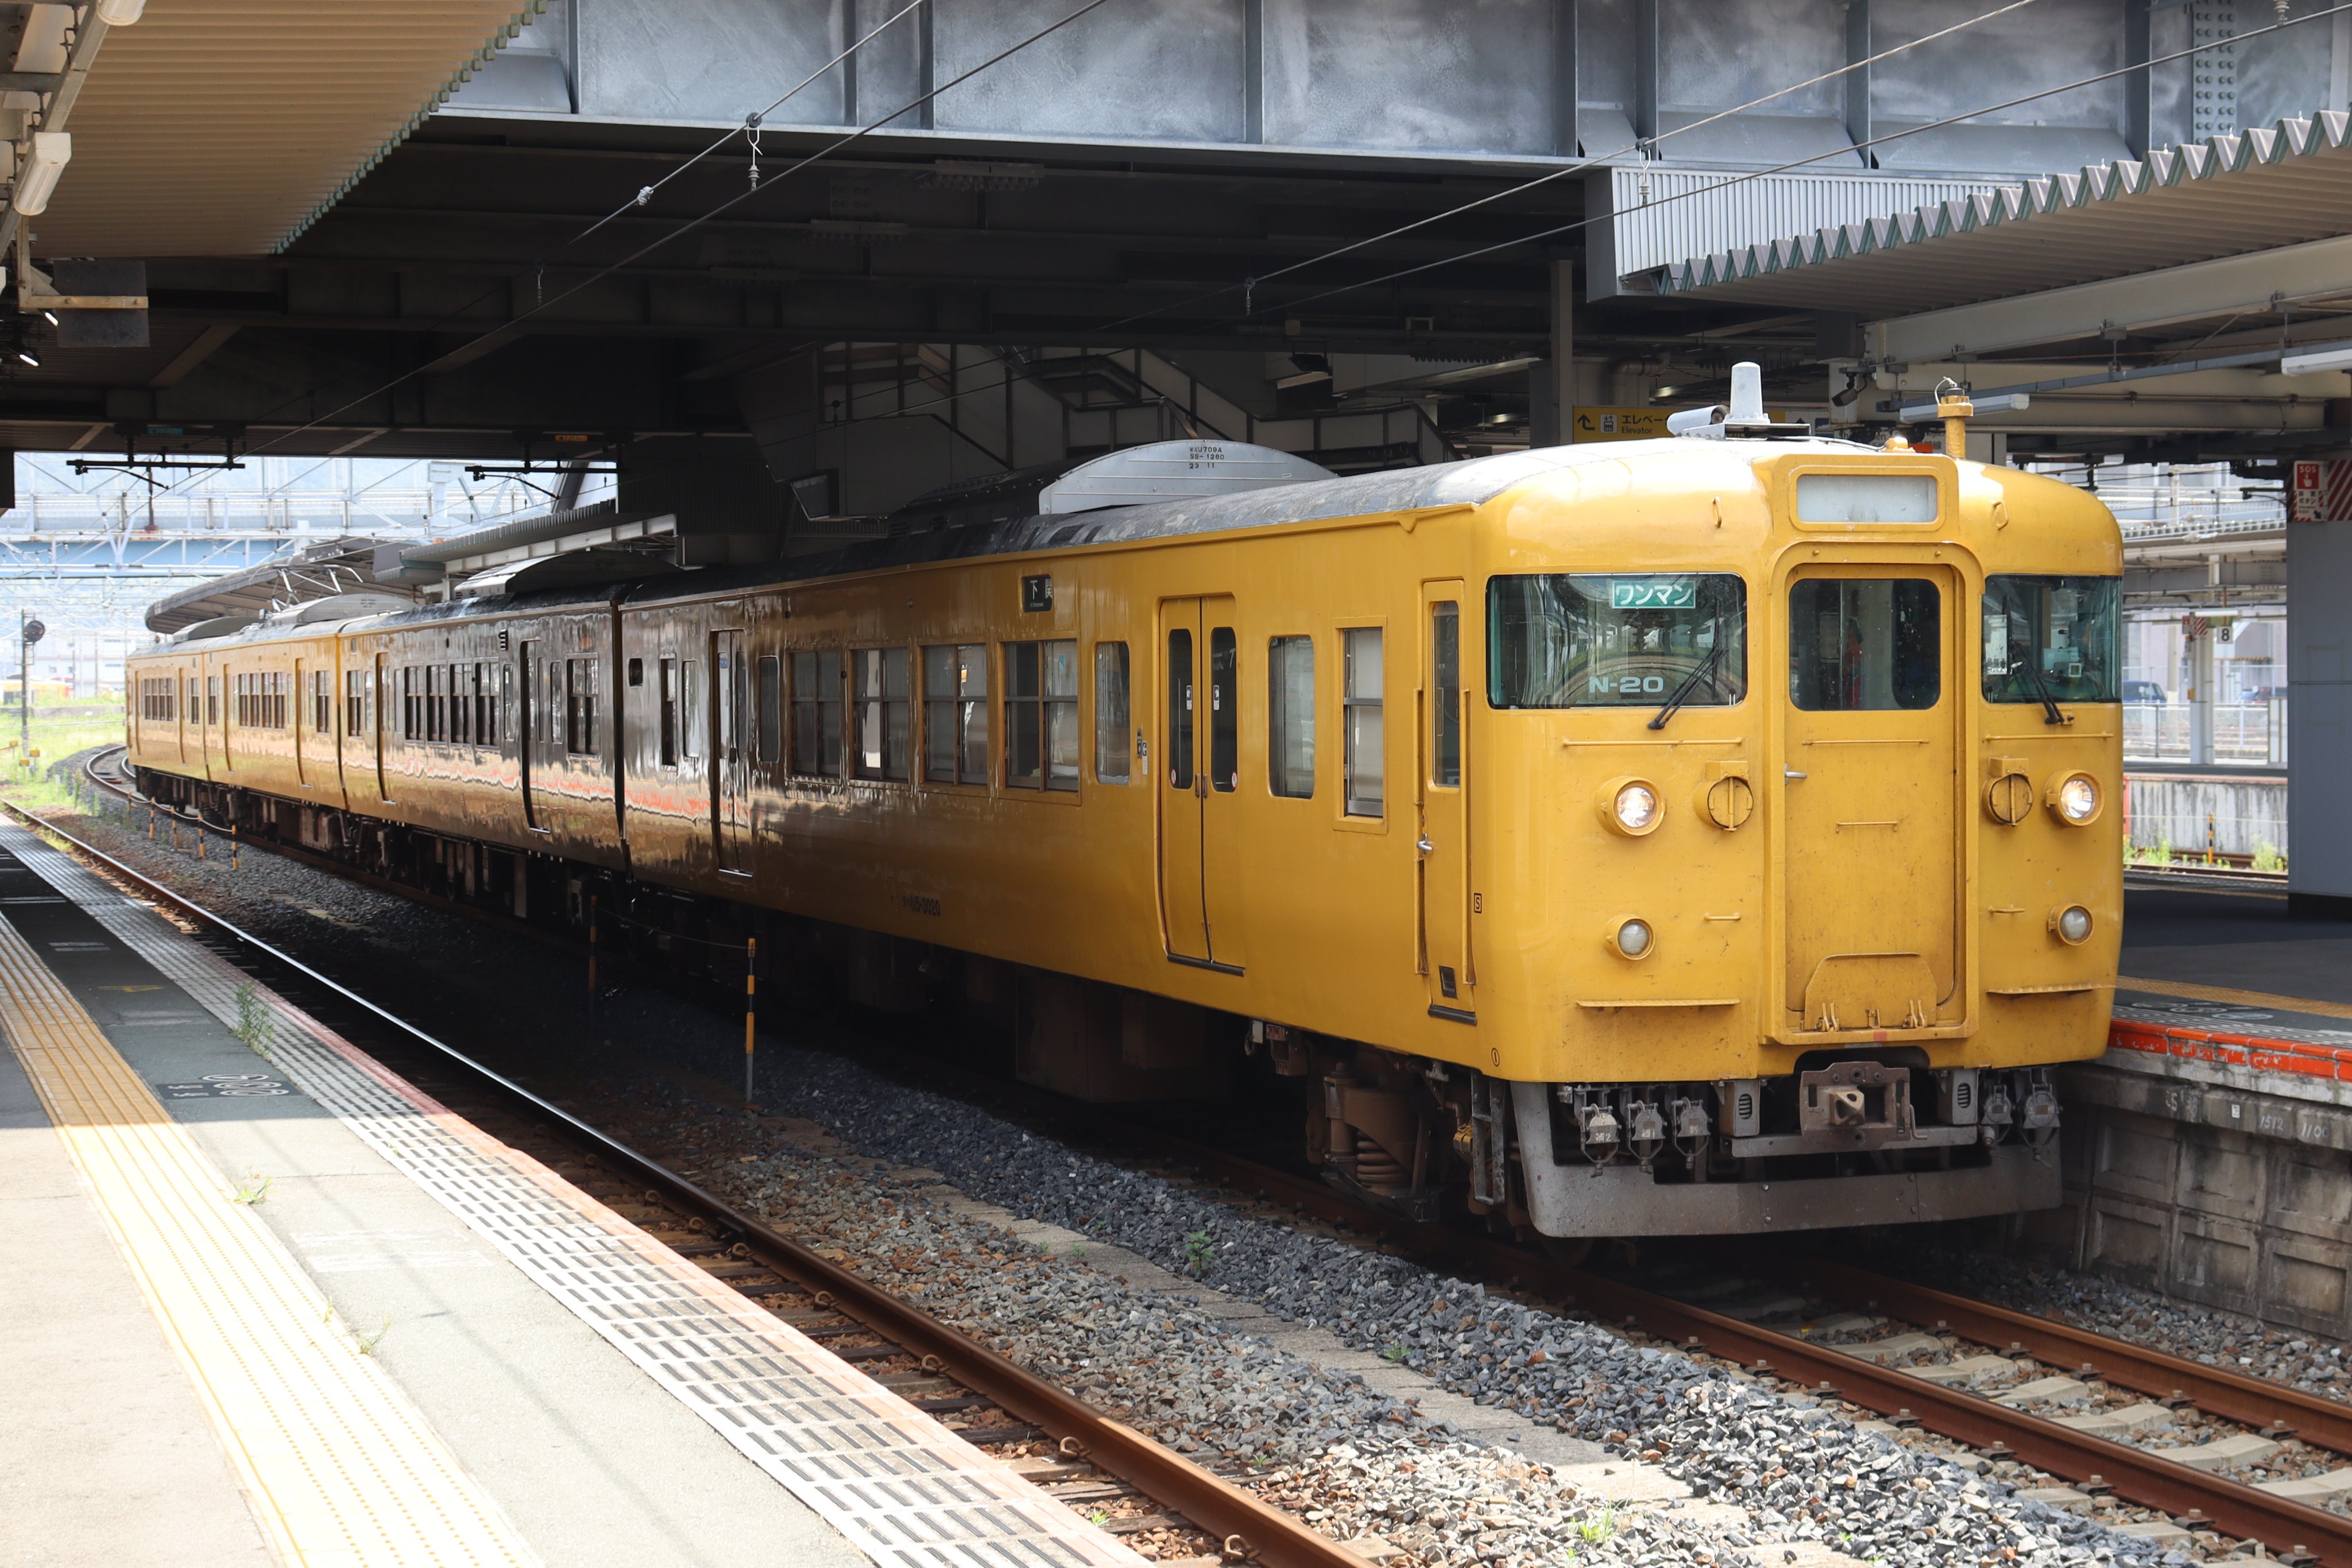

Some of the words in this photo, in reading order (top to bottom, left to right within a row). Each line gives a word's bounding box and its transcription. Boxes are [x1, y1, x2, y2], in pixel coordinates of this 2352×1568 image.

[1622, 415, 1668, 424] エレベー
[1622, 426, 1653, 434] Elevator
[1030, 579, 1053, 600] 下関
[1616, 584, 1692, 605] ワンマン
[2221, 628, 2230, 641] 8
[1589, 676, 1664, 693] N-20
[2260, 1114, 2285, 1131] 1512
[2301, 1123, 2330, 1138] 1100
